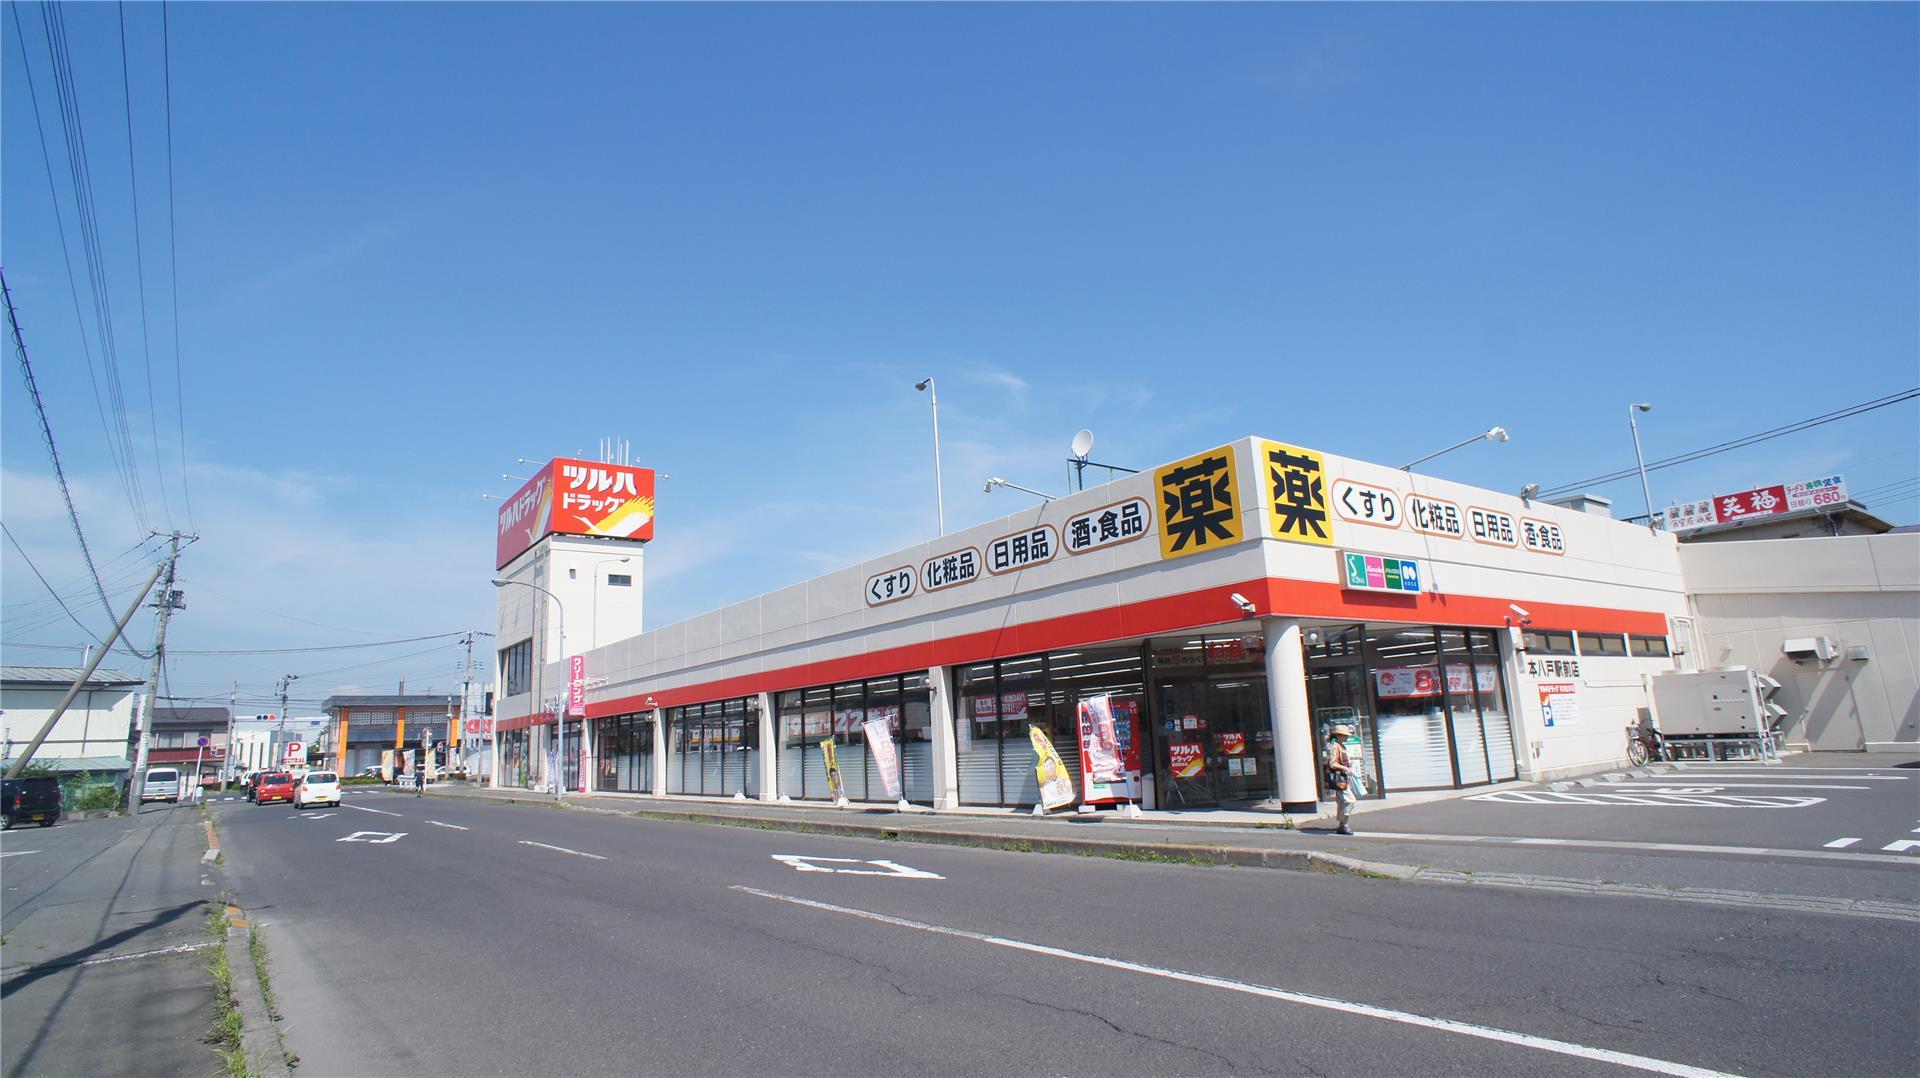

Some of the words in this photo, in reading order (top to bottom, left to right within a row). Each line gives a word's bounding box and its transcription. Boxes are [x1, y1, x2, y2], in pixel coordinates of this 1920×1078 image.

[563, 465, 637, 496] ツルハ
[1268, 449, 1329, 539] 薬
[500, 476, 546, 535] ツルハドラッグ
[562, 492, 625, 513] ドラッグ
[1161, 455, 1236, 553] 薬
[1341, 486, 1395, 522] くすり
[1412, 498, 1460, 534] 化粧品
[1722, 490, 1778, 517] 笑福
[1071, 501, 1143, 550] 酒・食品
[1472, 510, 1514, 543] 日用品
[994, 530, 1050, 569] 日用品
[926, 551, 975, 588] 化粧品
[870, 573, 913, 600] くすり
[1527, 659, 1580, 679] 本八戸駅前店
[1543, 706, 1552, 726] P
[288, 742, 302, 757] P
[1170, 744, 1201, 755] ツルハ
[1171, 755, 1194, 763] ドラッグ
